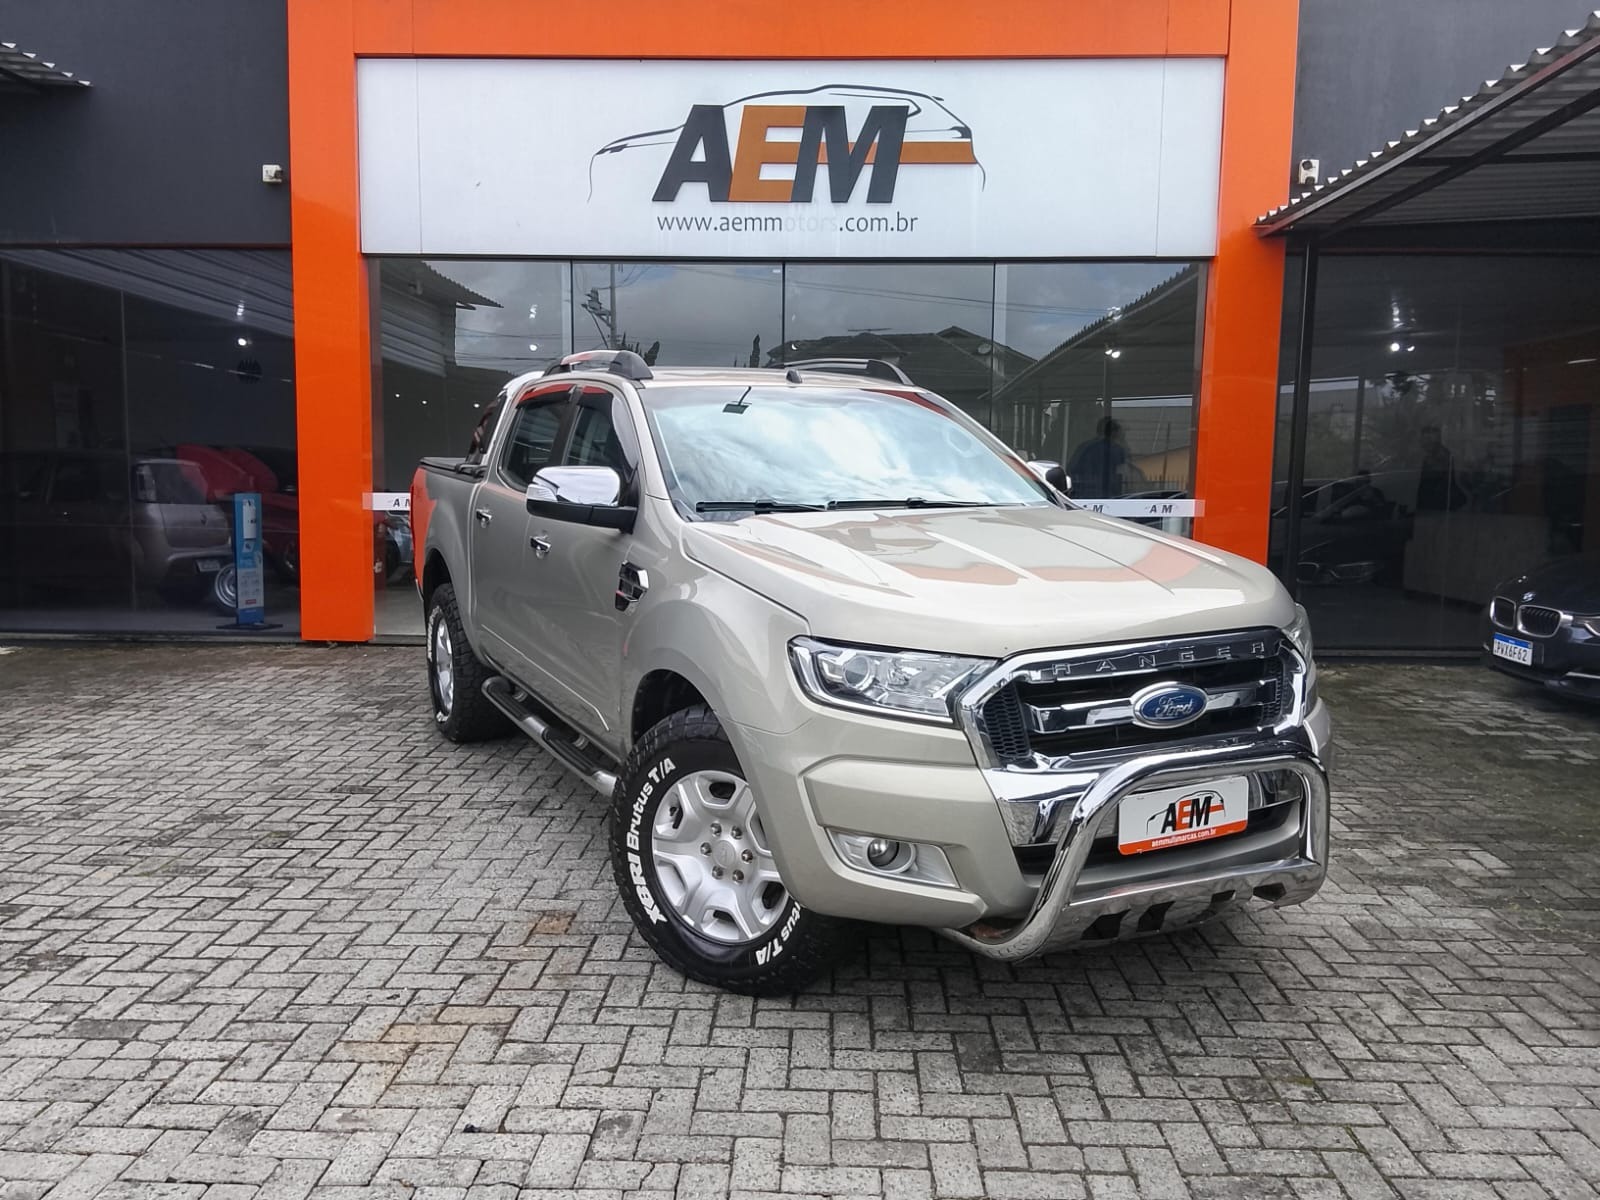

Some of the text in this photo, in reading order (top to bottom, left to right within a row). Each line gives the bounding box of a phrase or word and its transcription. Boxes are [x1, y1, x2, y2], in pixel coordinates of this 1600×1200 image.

[652, 104, 909, 203] AEM
[1052, 642, 1265, 675] RANGER
[1155, 694, 1194, 717] Ford
[626, 781, 654, 851] Brutus
[647, 757, 677, 784] T/A
[1161, 795, 1212, 834] AEM
[755, 937, 784, 967] T/A
